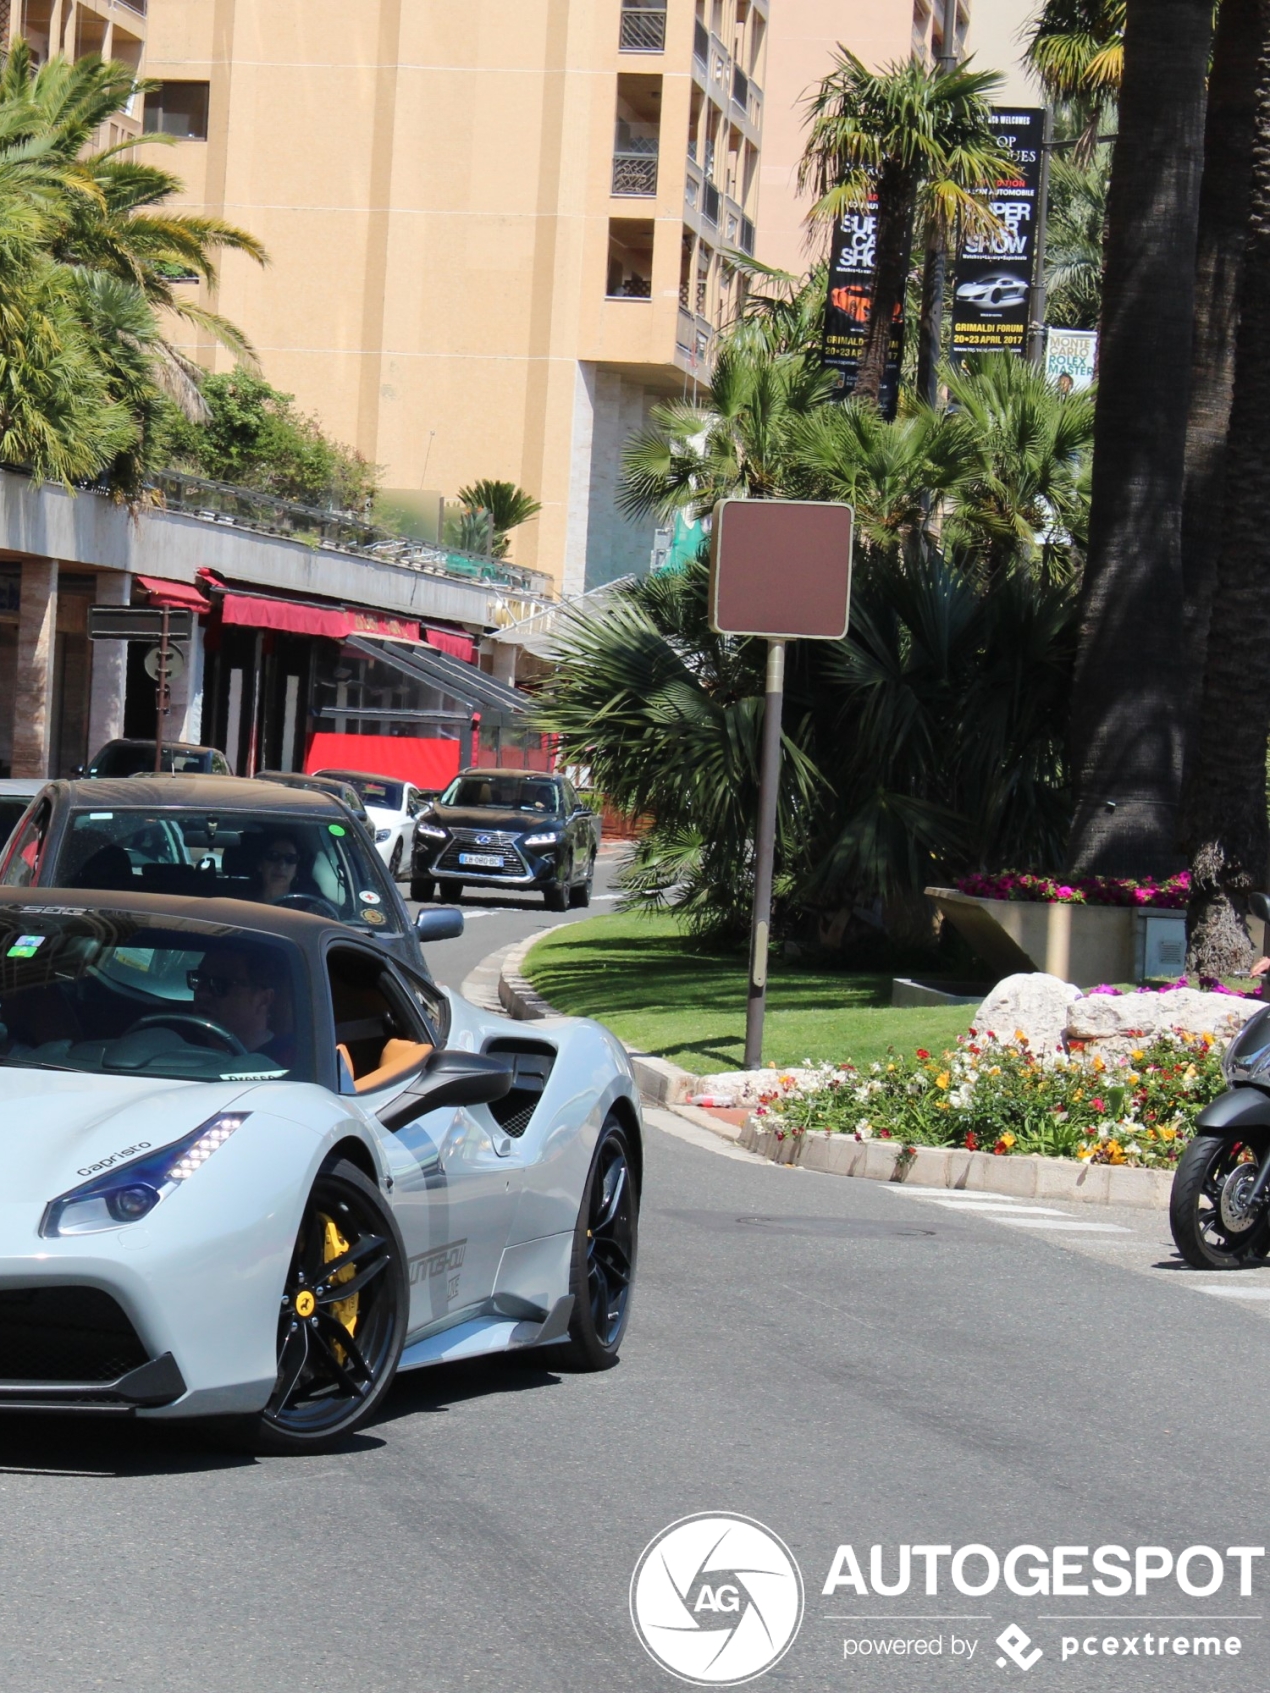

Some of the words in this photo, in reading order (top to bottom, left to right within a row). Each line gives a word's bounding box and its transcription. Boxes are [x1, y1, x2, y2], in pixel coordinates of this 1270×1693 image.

[996, 136, 1017, 148] OP
[989, 202, 1031, 220] PER
[852, 233, 876, 250] CA
[955, 323, 995, 332] GRIMALDI
[996, 324, 1024, 332] FORUM
[826, 336, 864, 346] GRIMALD
[1003, 336, 1023, 344] 2017
[1049, 338, 1091, 348] MONTE
[1049, 346, 1089, 357] CARLO
[1049, 355, 1087, 366] ROLEX
[1048, 365, 1094, 376] MASTER
[77, 1141, 152, 1177] Capristo
